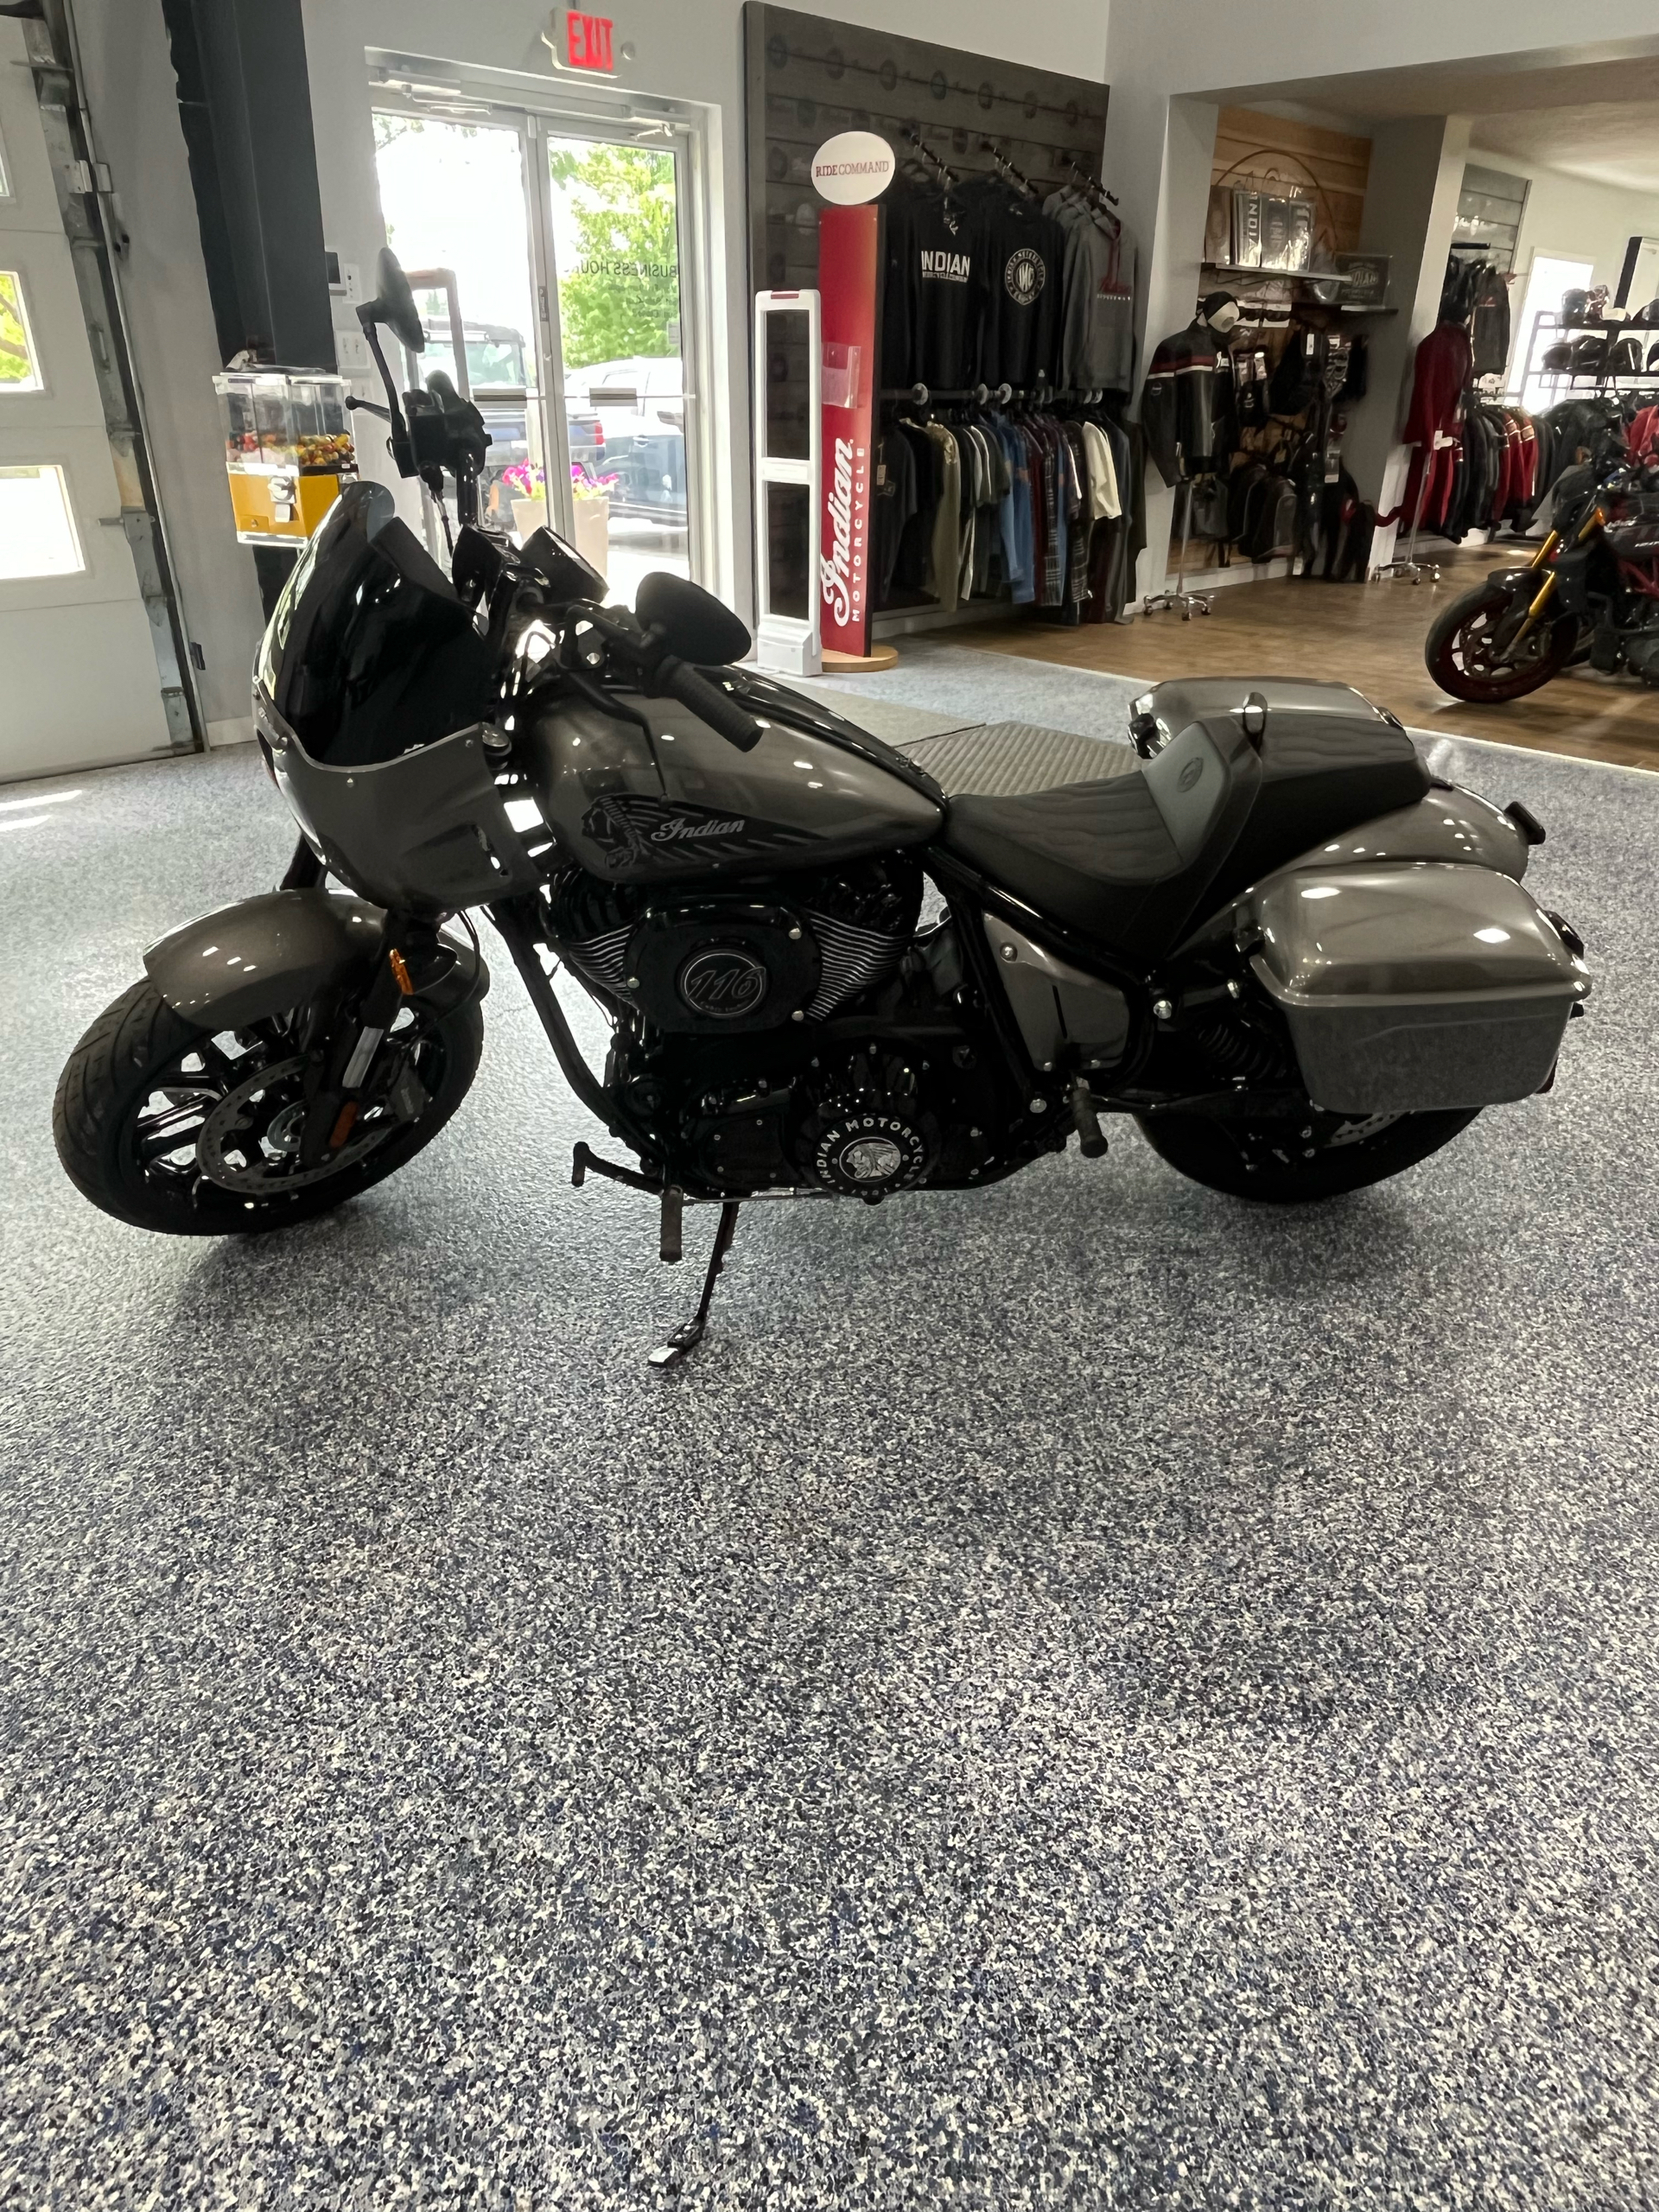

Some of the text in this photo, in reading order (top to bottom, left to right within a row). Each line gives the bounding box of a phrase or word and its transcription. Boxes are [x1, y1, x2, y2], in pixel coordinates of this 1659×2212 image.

[567, 10, 613, 72] EXIT
[816, 160, 890, 177] RIDE COMMAND
[921, 251, 970, 276] INDIAN
[820, 437, 854, 627] Indian
[851, 448, 865, 622] MOTORCYCLE
[651, 817, 746, 842] Indian
[687, 966, 766, 1000] 116
[816, 1117, 924, 1184] INDIAN MOTORCYCLE
